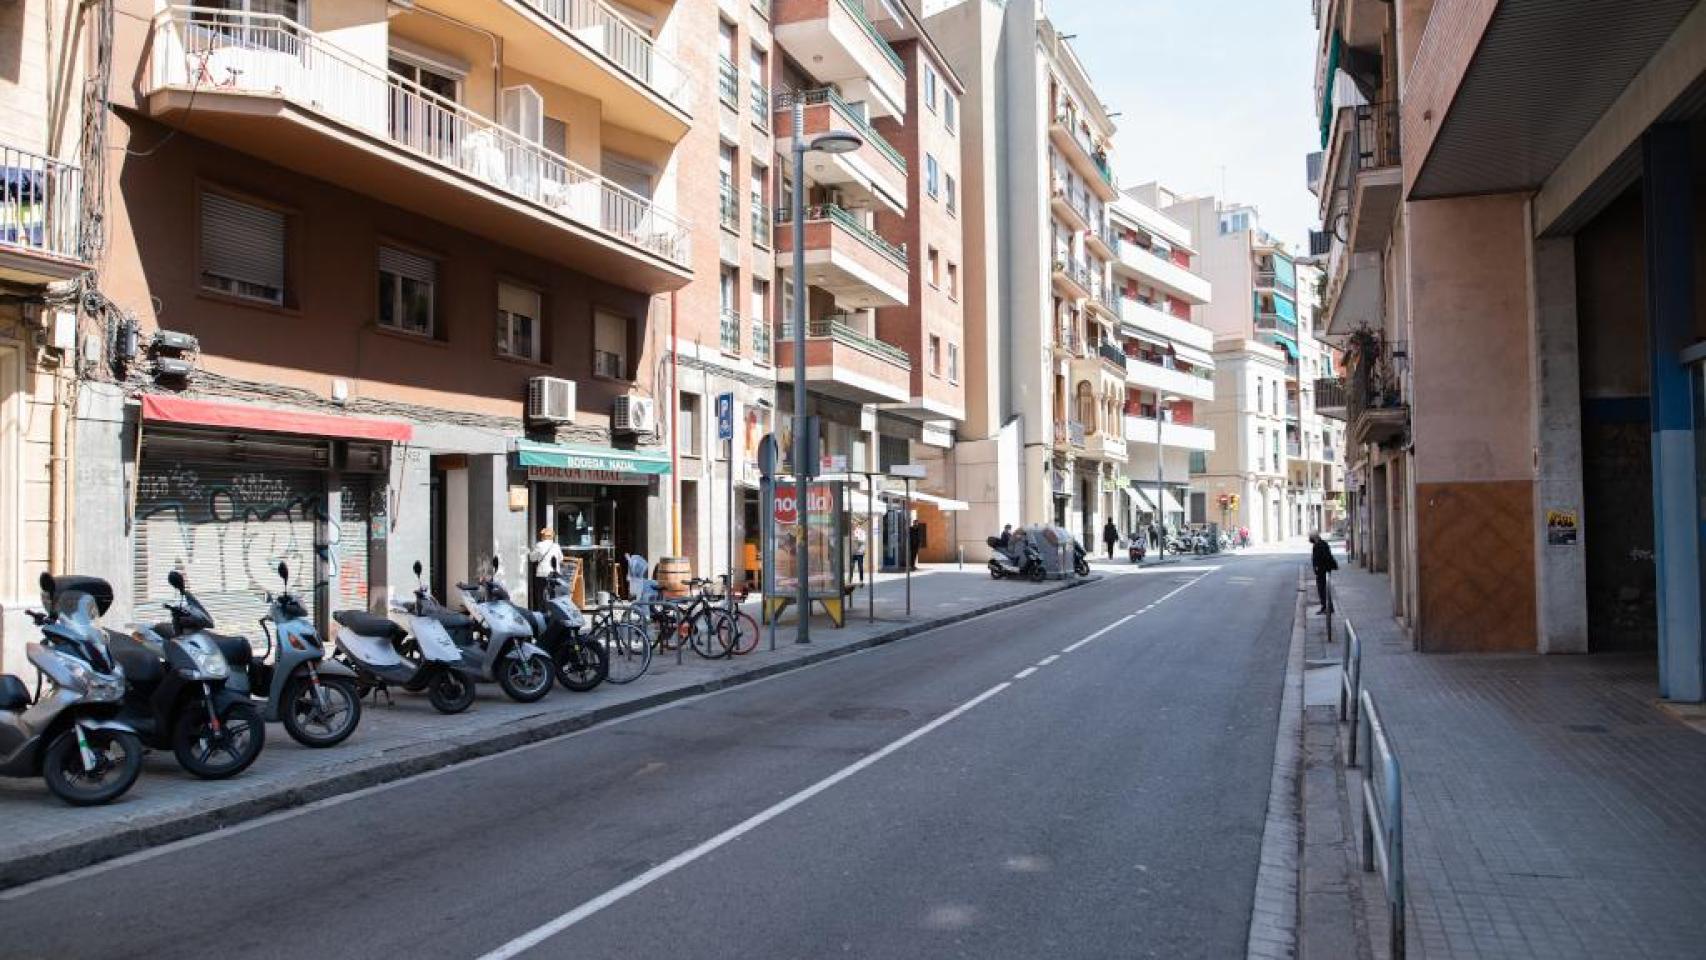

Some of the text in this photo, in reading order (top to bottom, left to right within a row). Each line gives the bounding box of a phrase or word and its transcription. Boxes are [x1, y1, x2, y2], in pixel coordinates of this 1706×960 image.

[567, 456, 638, 471] BODEGA NADAL
[528, 465, 620, 481] BODEGA NADAL
